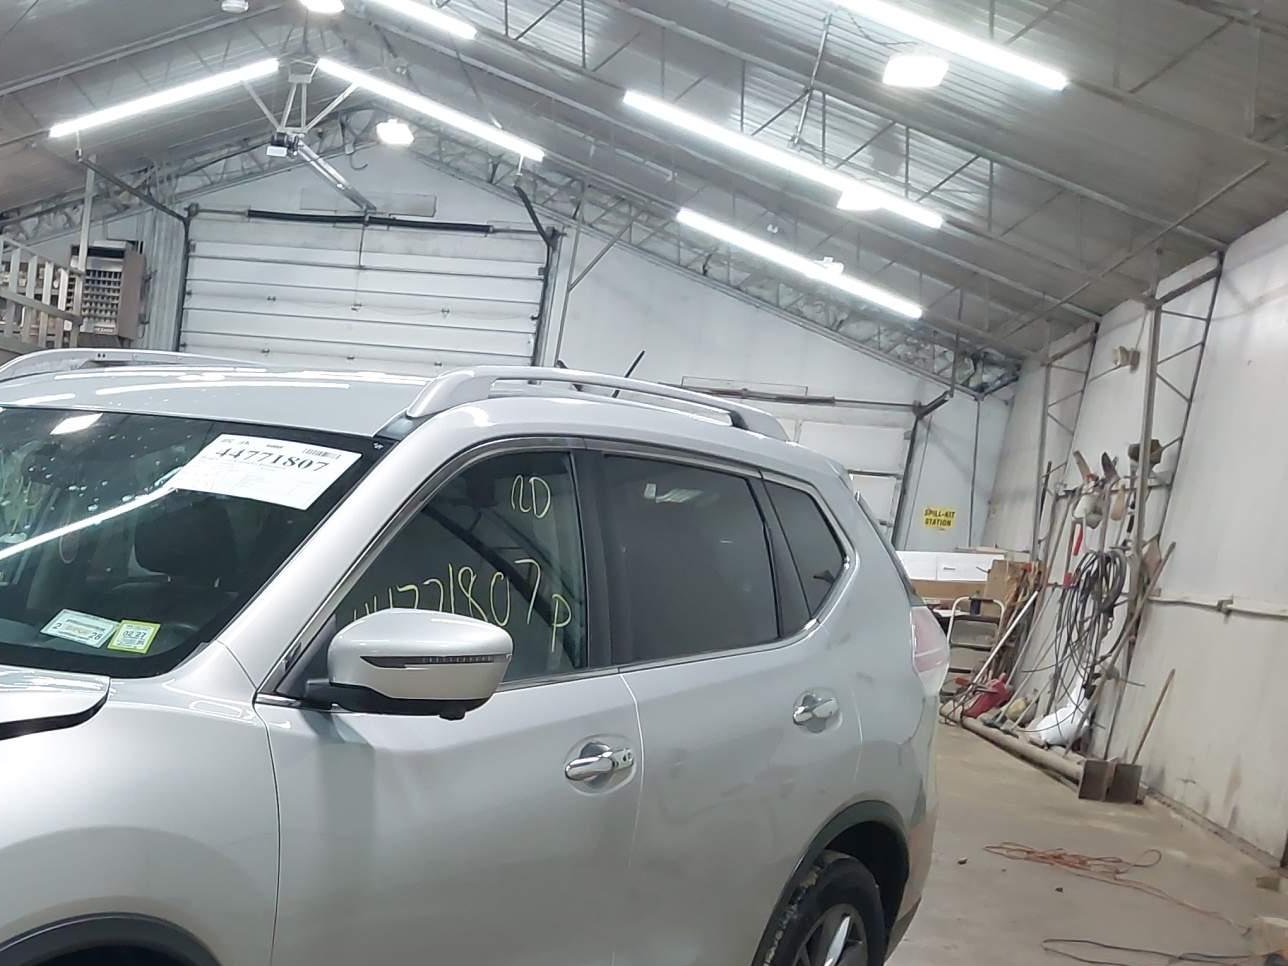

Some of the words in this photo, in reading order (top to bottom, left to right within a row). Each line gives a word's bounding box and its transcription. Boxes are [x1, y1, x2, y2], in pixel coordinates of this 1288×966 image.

[215, 447, 330, 472] 44771807
[924, 518, 952, 526] STATION
[353, 558, 541, 627] 771807
